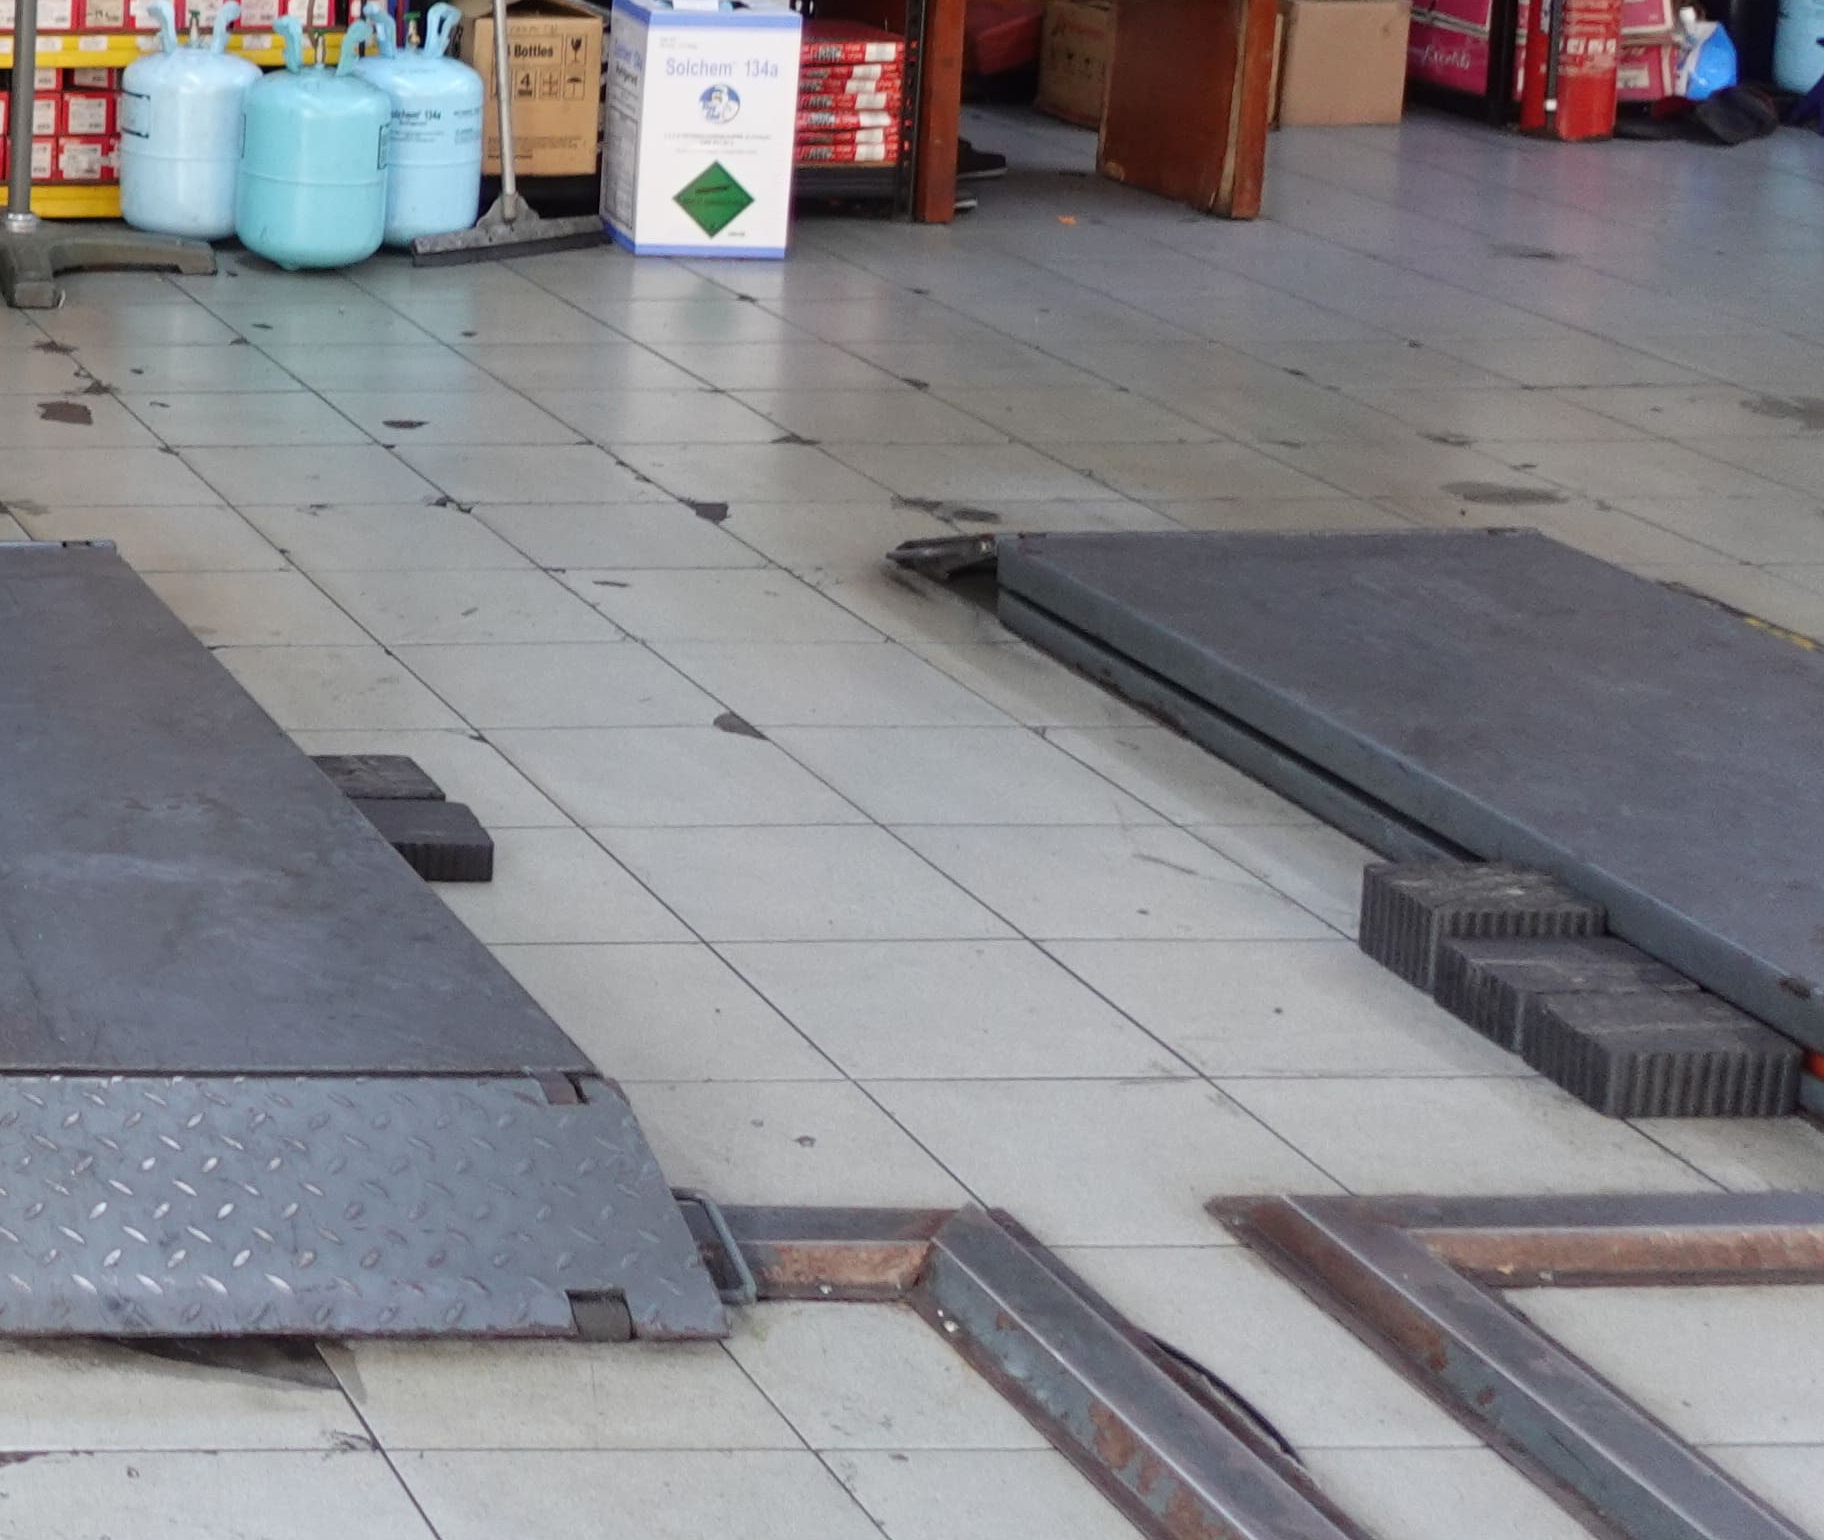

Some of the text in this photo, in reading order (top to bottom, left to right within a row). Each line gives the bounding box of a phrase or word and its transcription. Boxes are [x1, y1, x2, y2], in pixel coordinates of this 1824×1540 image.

[514, 43, 554, 58] Bottles
[665, 58, 780, 78] Solchem 134a
[521, 73, 532, 87] 4
